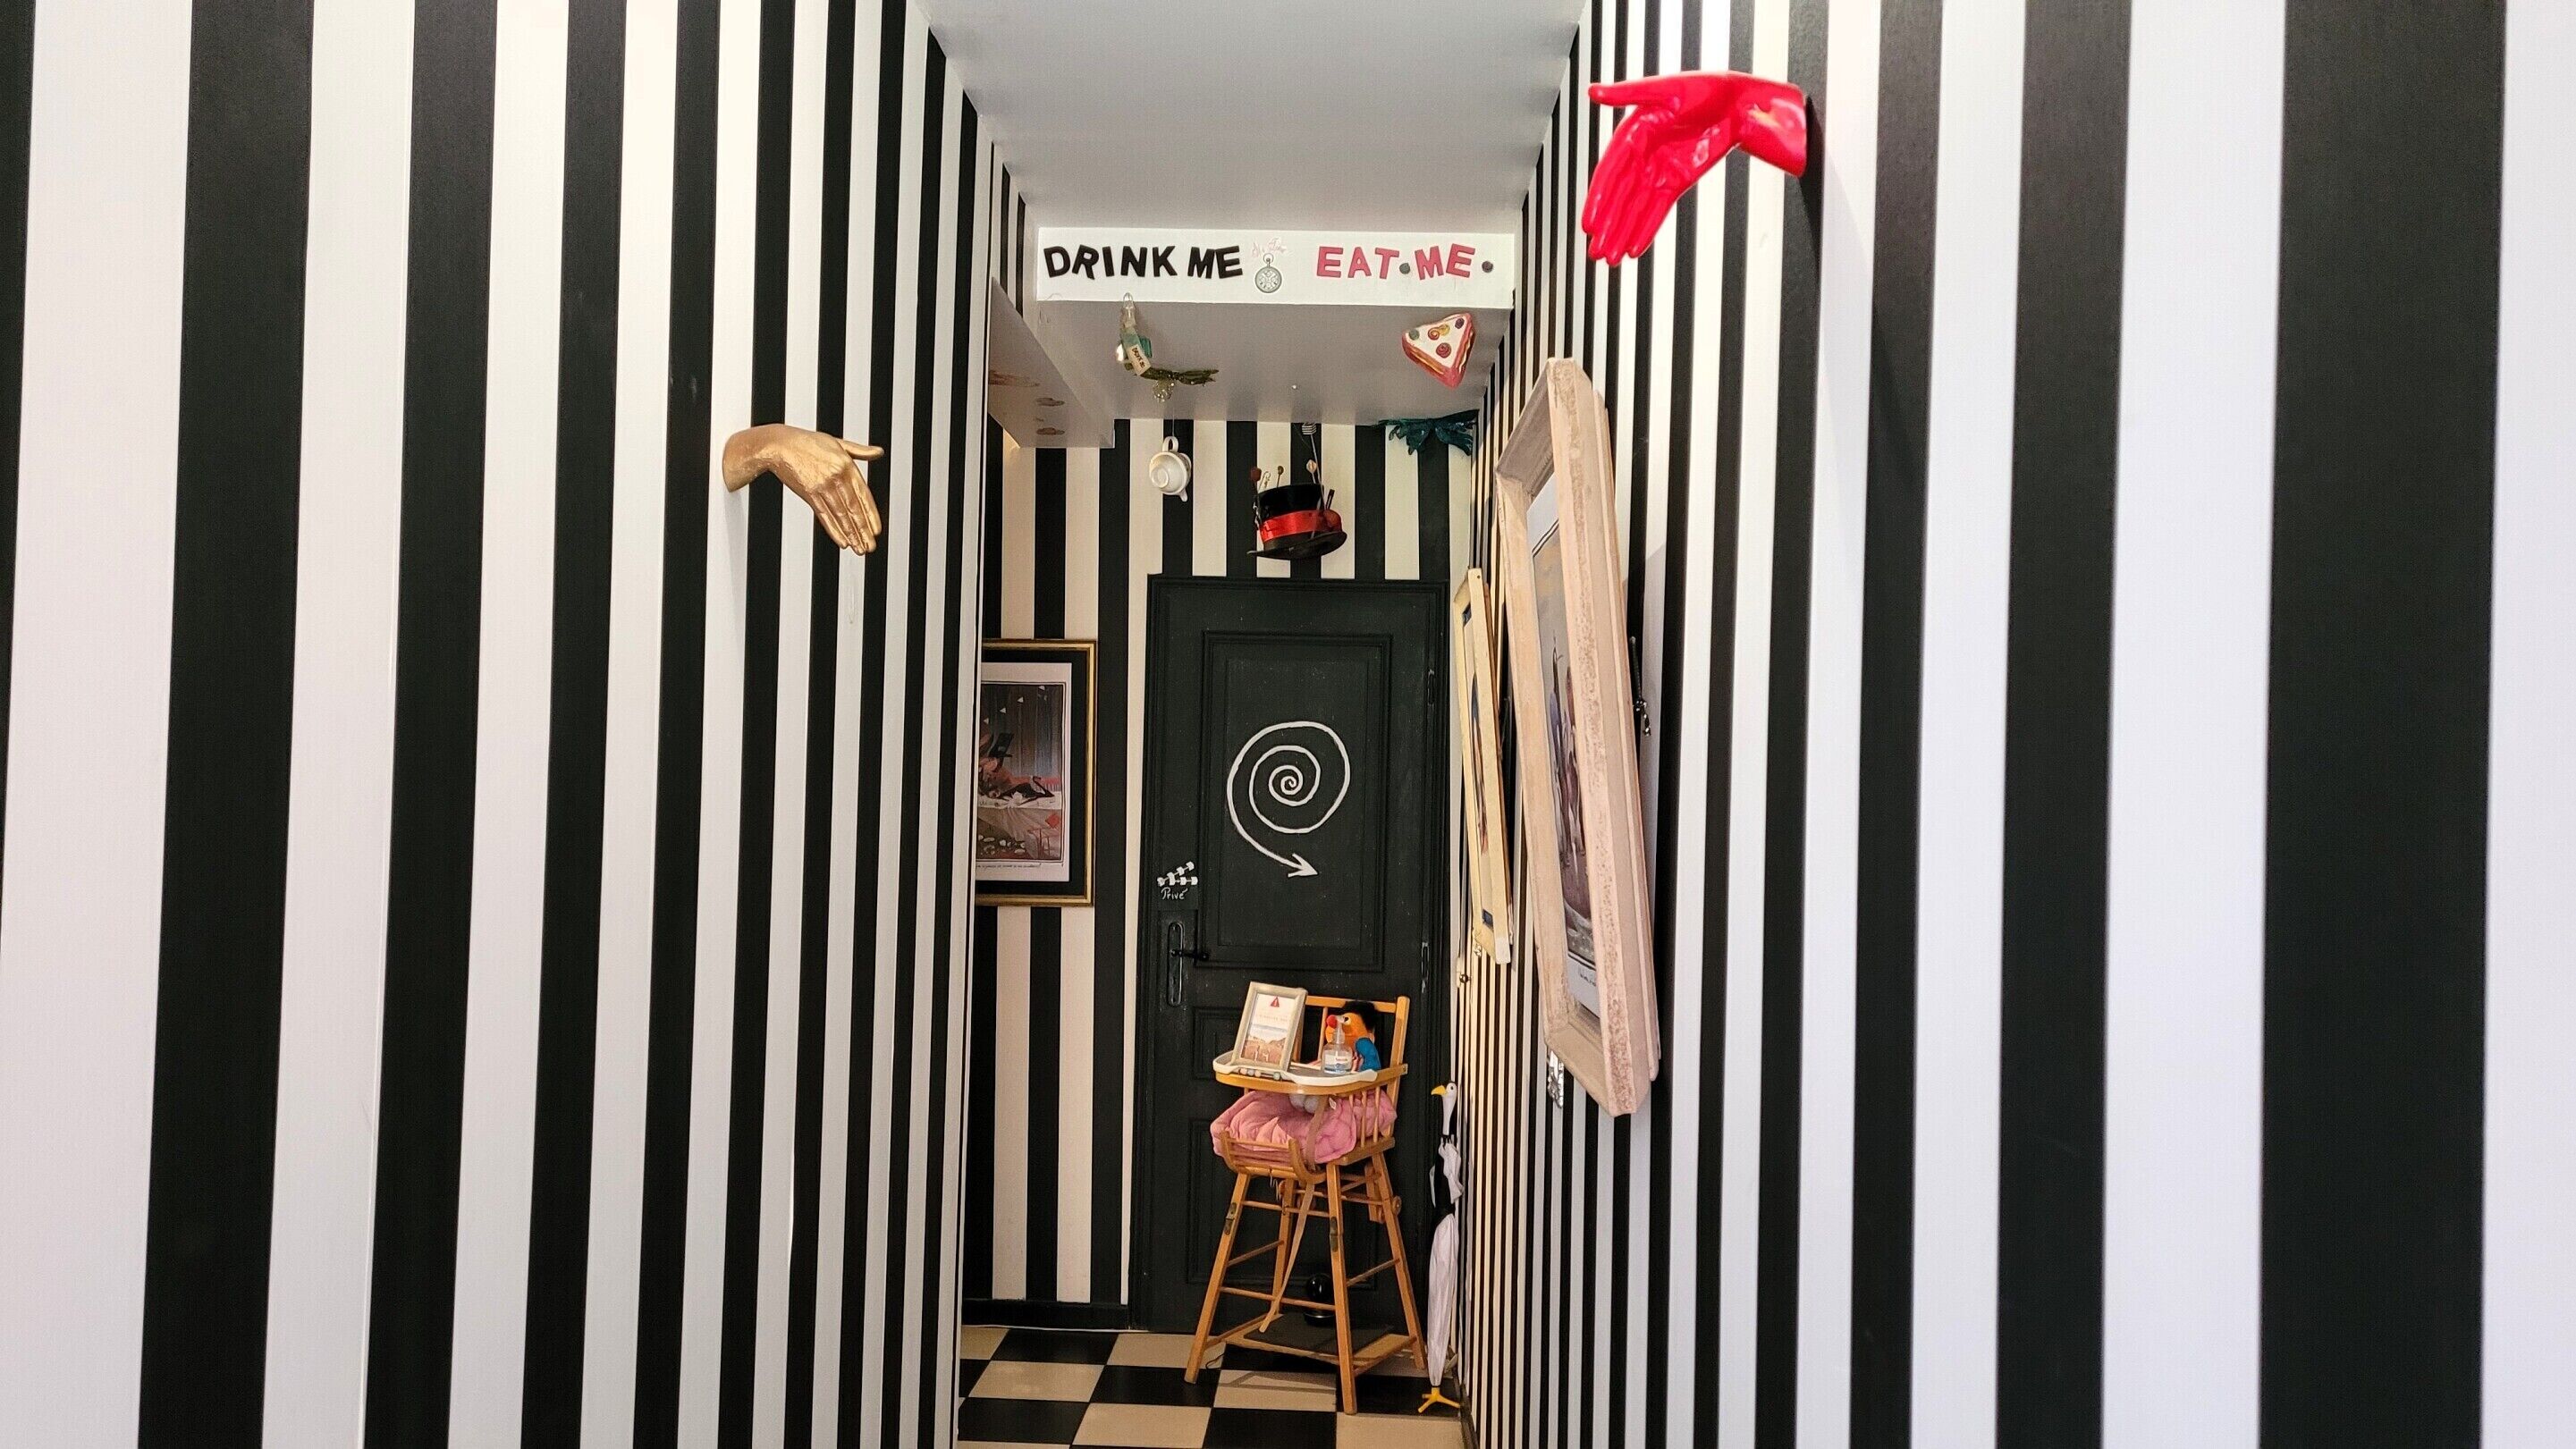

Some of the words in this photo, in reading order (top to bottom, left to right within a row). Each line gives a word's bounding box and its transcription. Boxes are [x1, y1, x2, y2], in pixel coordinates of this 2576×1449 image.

[1043, 244, 1178, 280] DRINK
[1187, 245, 1243, 279] ME
[1317, 246, 1400, 280] EAT
[1415, 243, 1476, 280] ME
[1161, 887, 1188, 900] Privé
